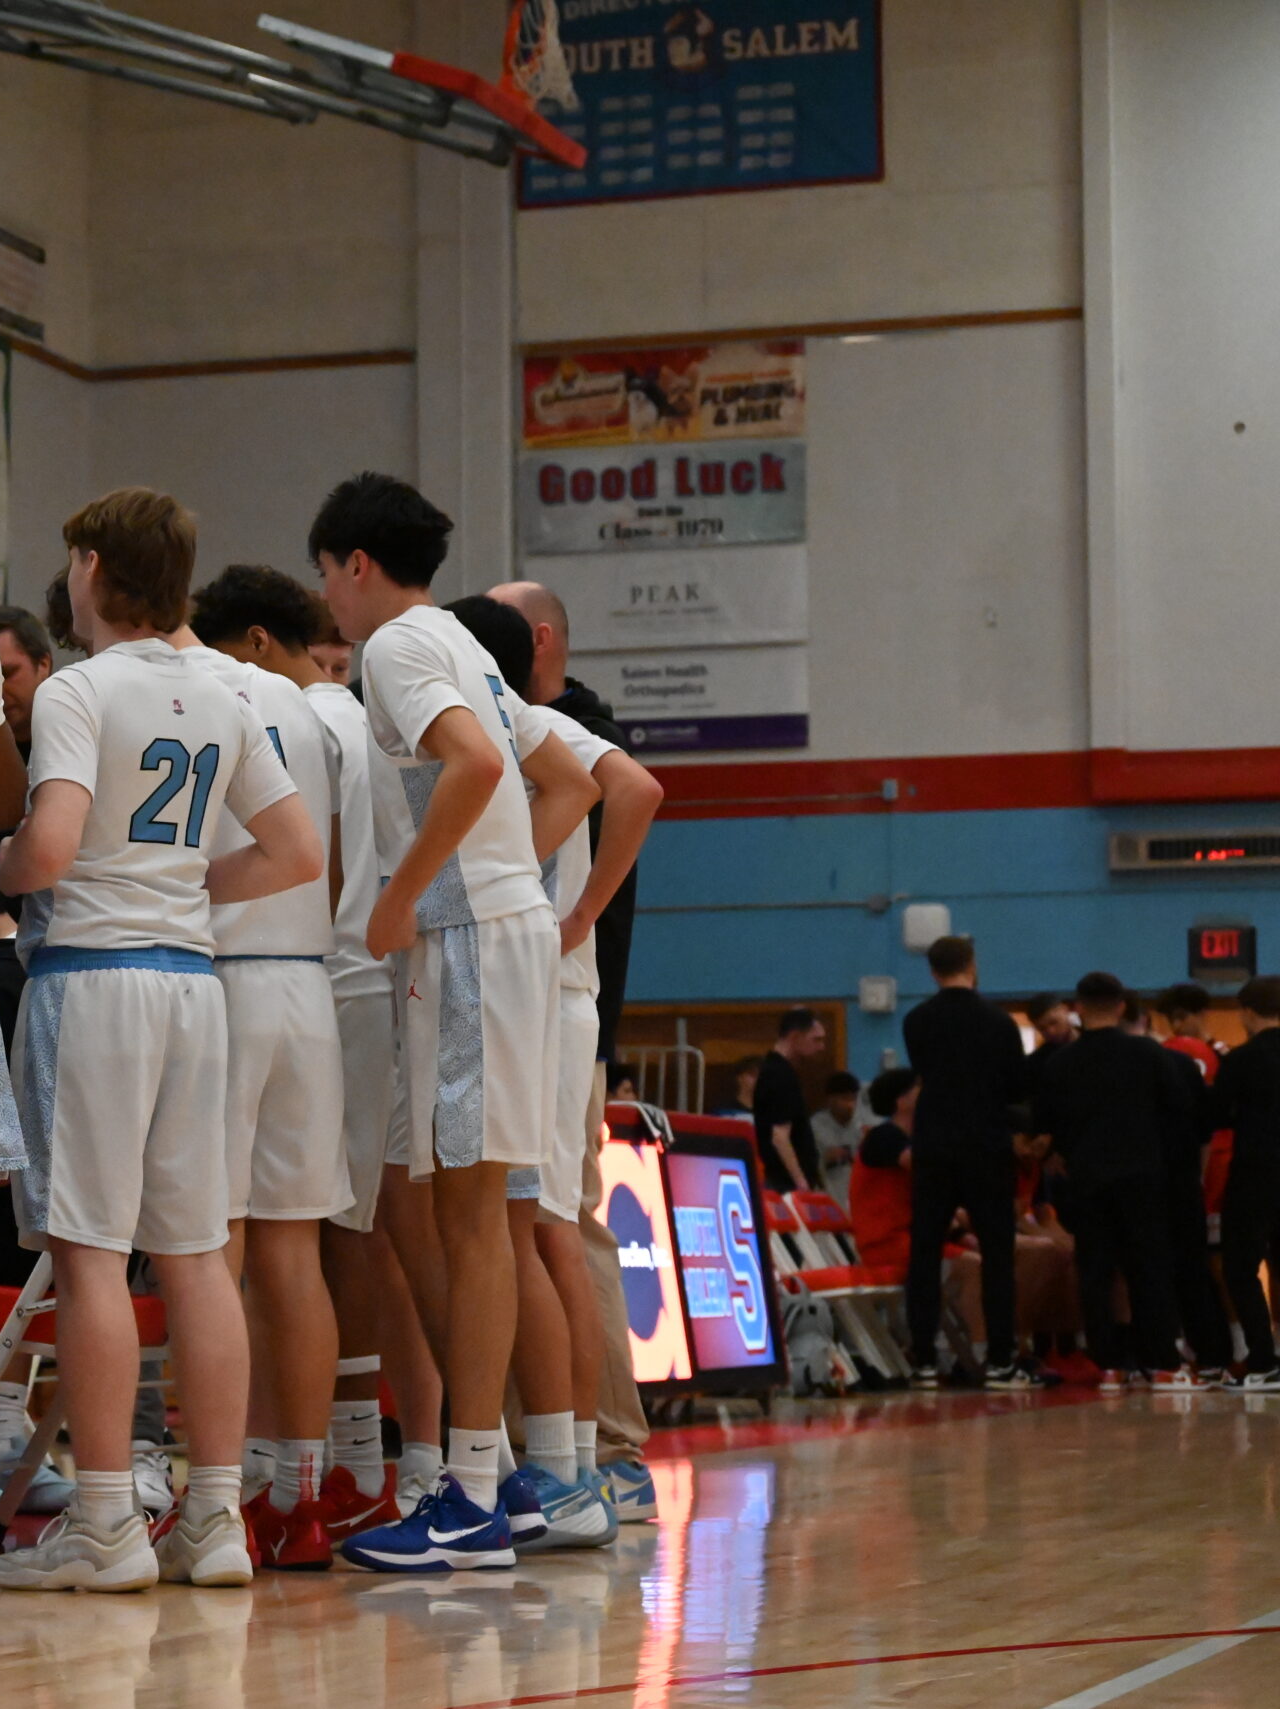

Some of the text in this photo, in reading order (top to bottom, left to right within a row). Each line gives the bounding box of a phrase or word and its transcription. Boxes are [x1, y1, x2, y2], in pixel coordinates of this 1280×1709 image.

[562, 18, 859, 75] OUTH SALEM
[538, 452, 786, 505] Good Luck
[630, 582, 700, 605] PEAK
[128, 737, 221, 848] 21
